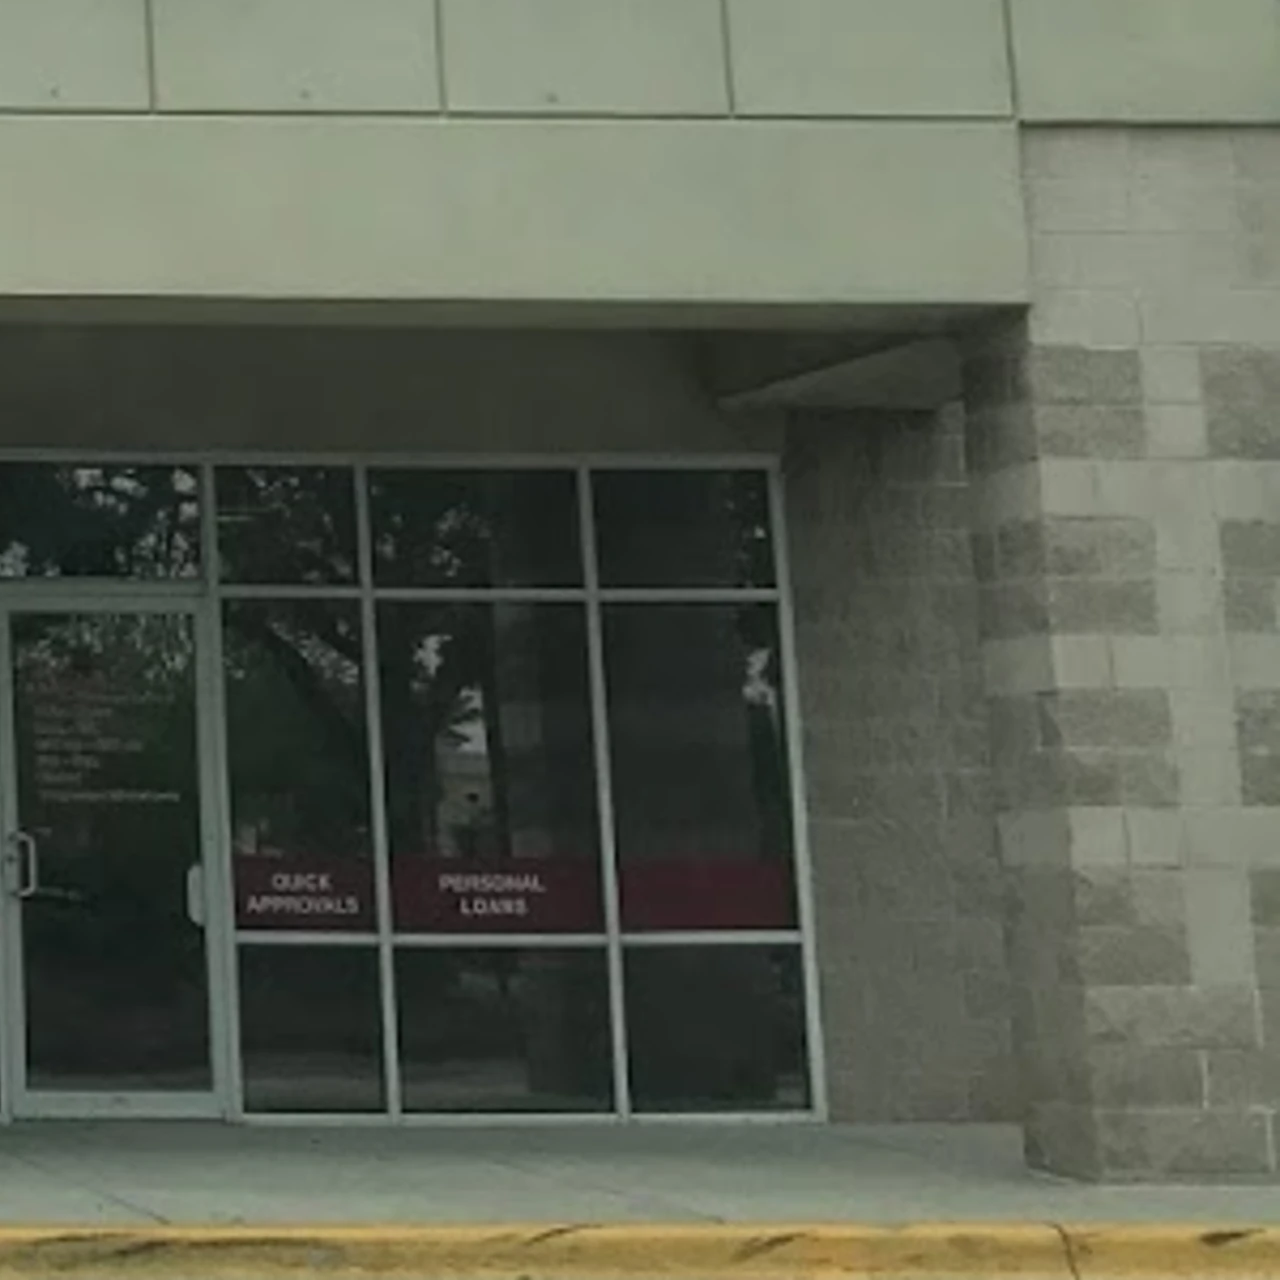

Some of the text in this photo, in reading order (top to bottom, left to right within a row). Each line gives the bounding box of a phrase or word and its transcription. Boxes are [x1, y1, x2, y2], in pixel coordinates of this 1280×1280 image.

[271, 873, 333, 891] QUICK
[440, 874, 545, 893] PERSONAL
[246, 895, 359, 915] APPROVALS
[460, 899, 527, 916] LOANS
